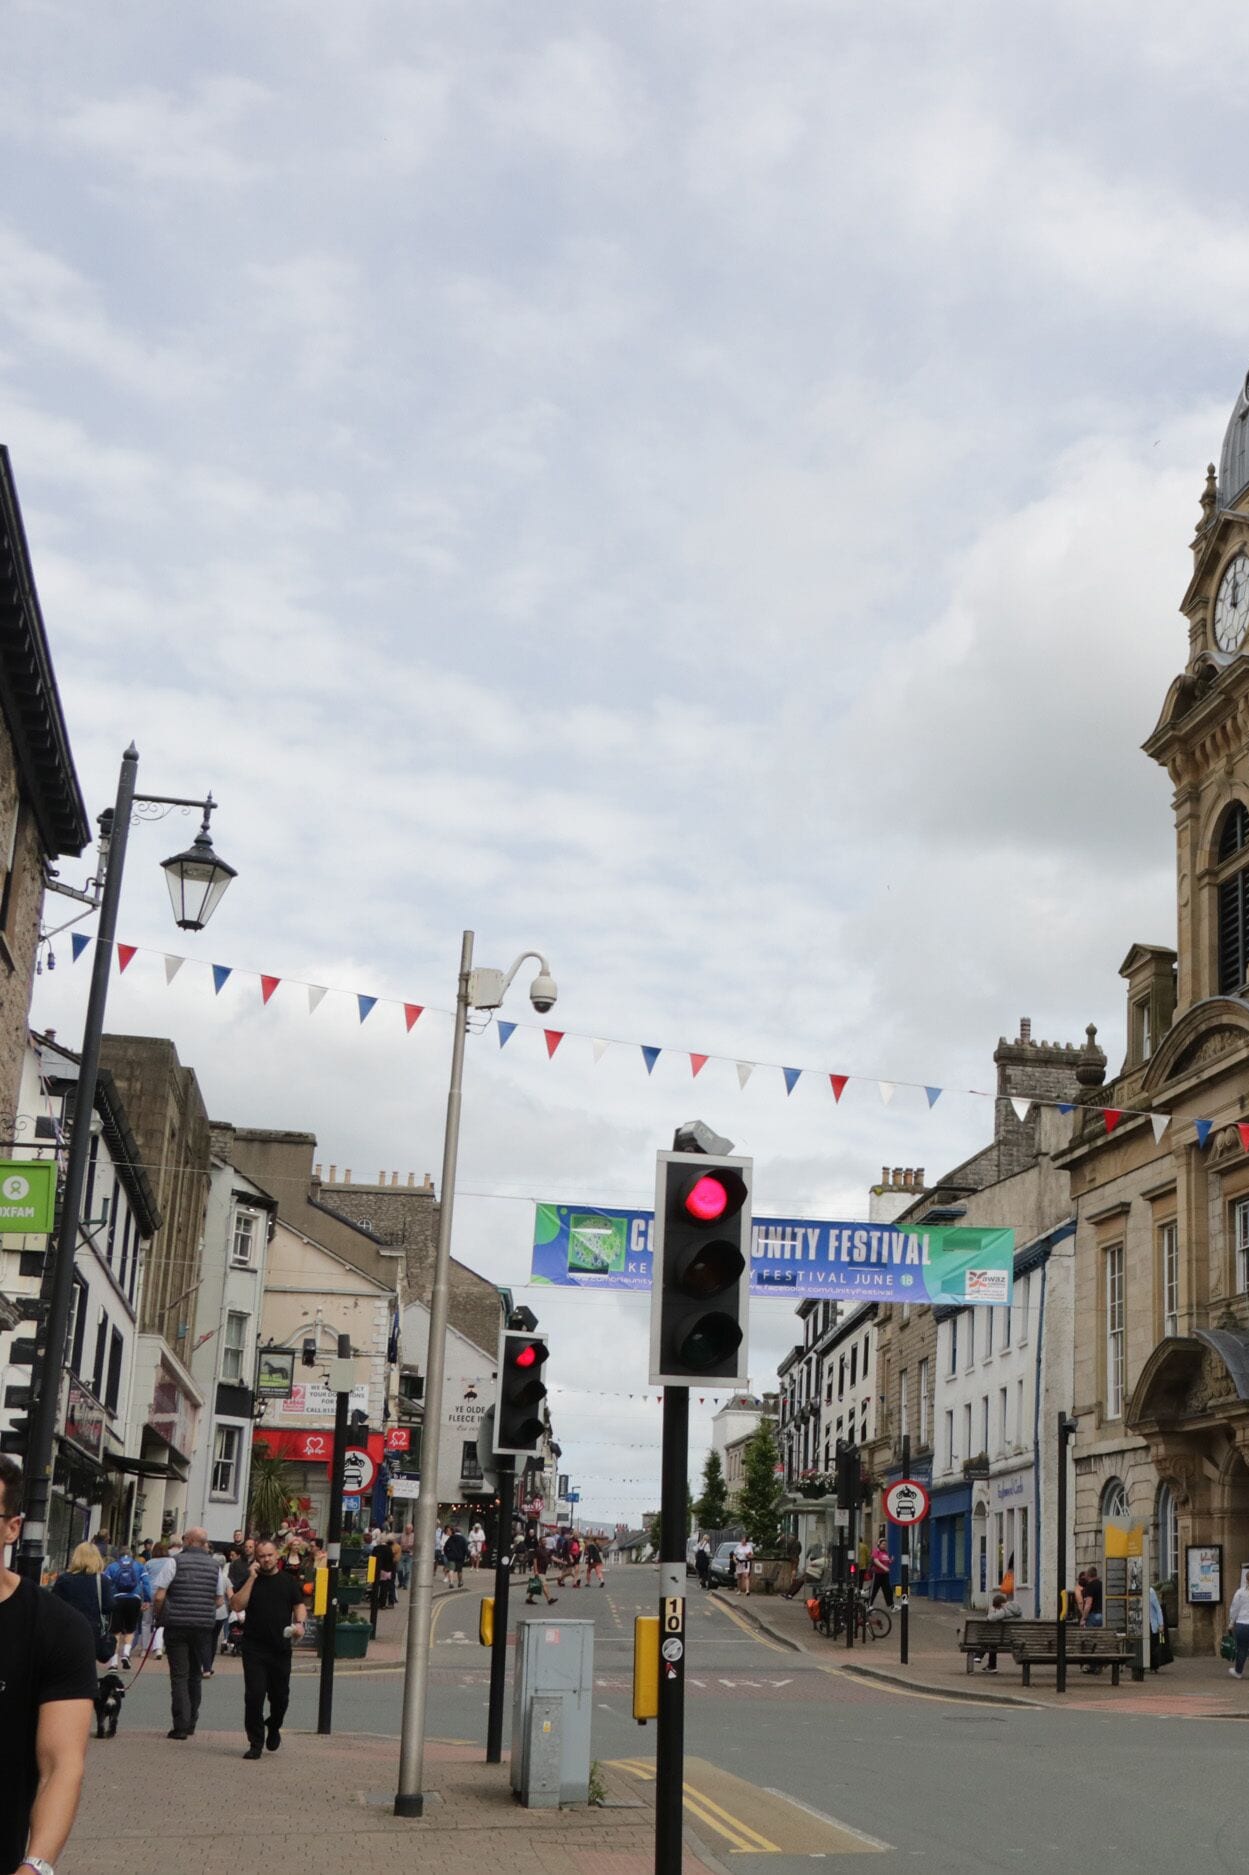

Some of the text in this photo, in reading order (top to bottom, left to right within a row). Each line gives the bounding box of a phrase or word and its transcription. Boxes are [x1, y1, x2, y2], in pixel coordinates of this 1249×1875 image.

[828, 1229, 932, 1265] FESTIVAL
[763, 1269, 847, 1284] FESTIVAL
[855, 1272, 893, 1286] JUNE
[448, 1414, 475, 1423] FLEECE
